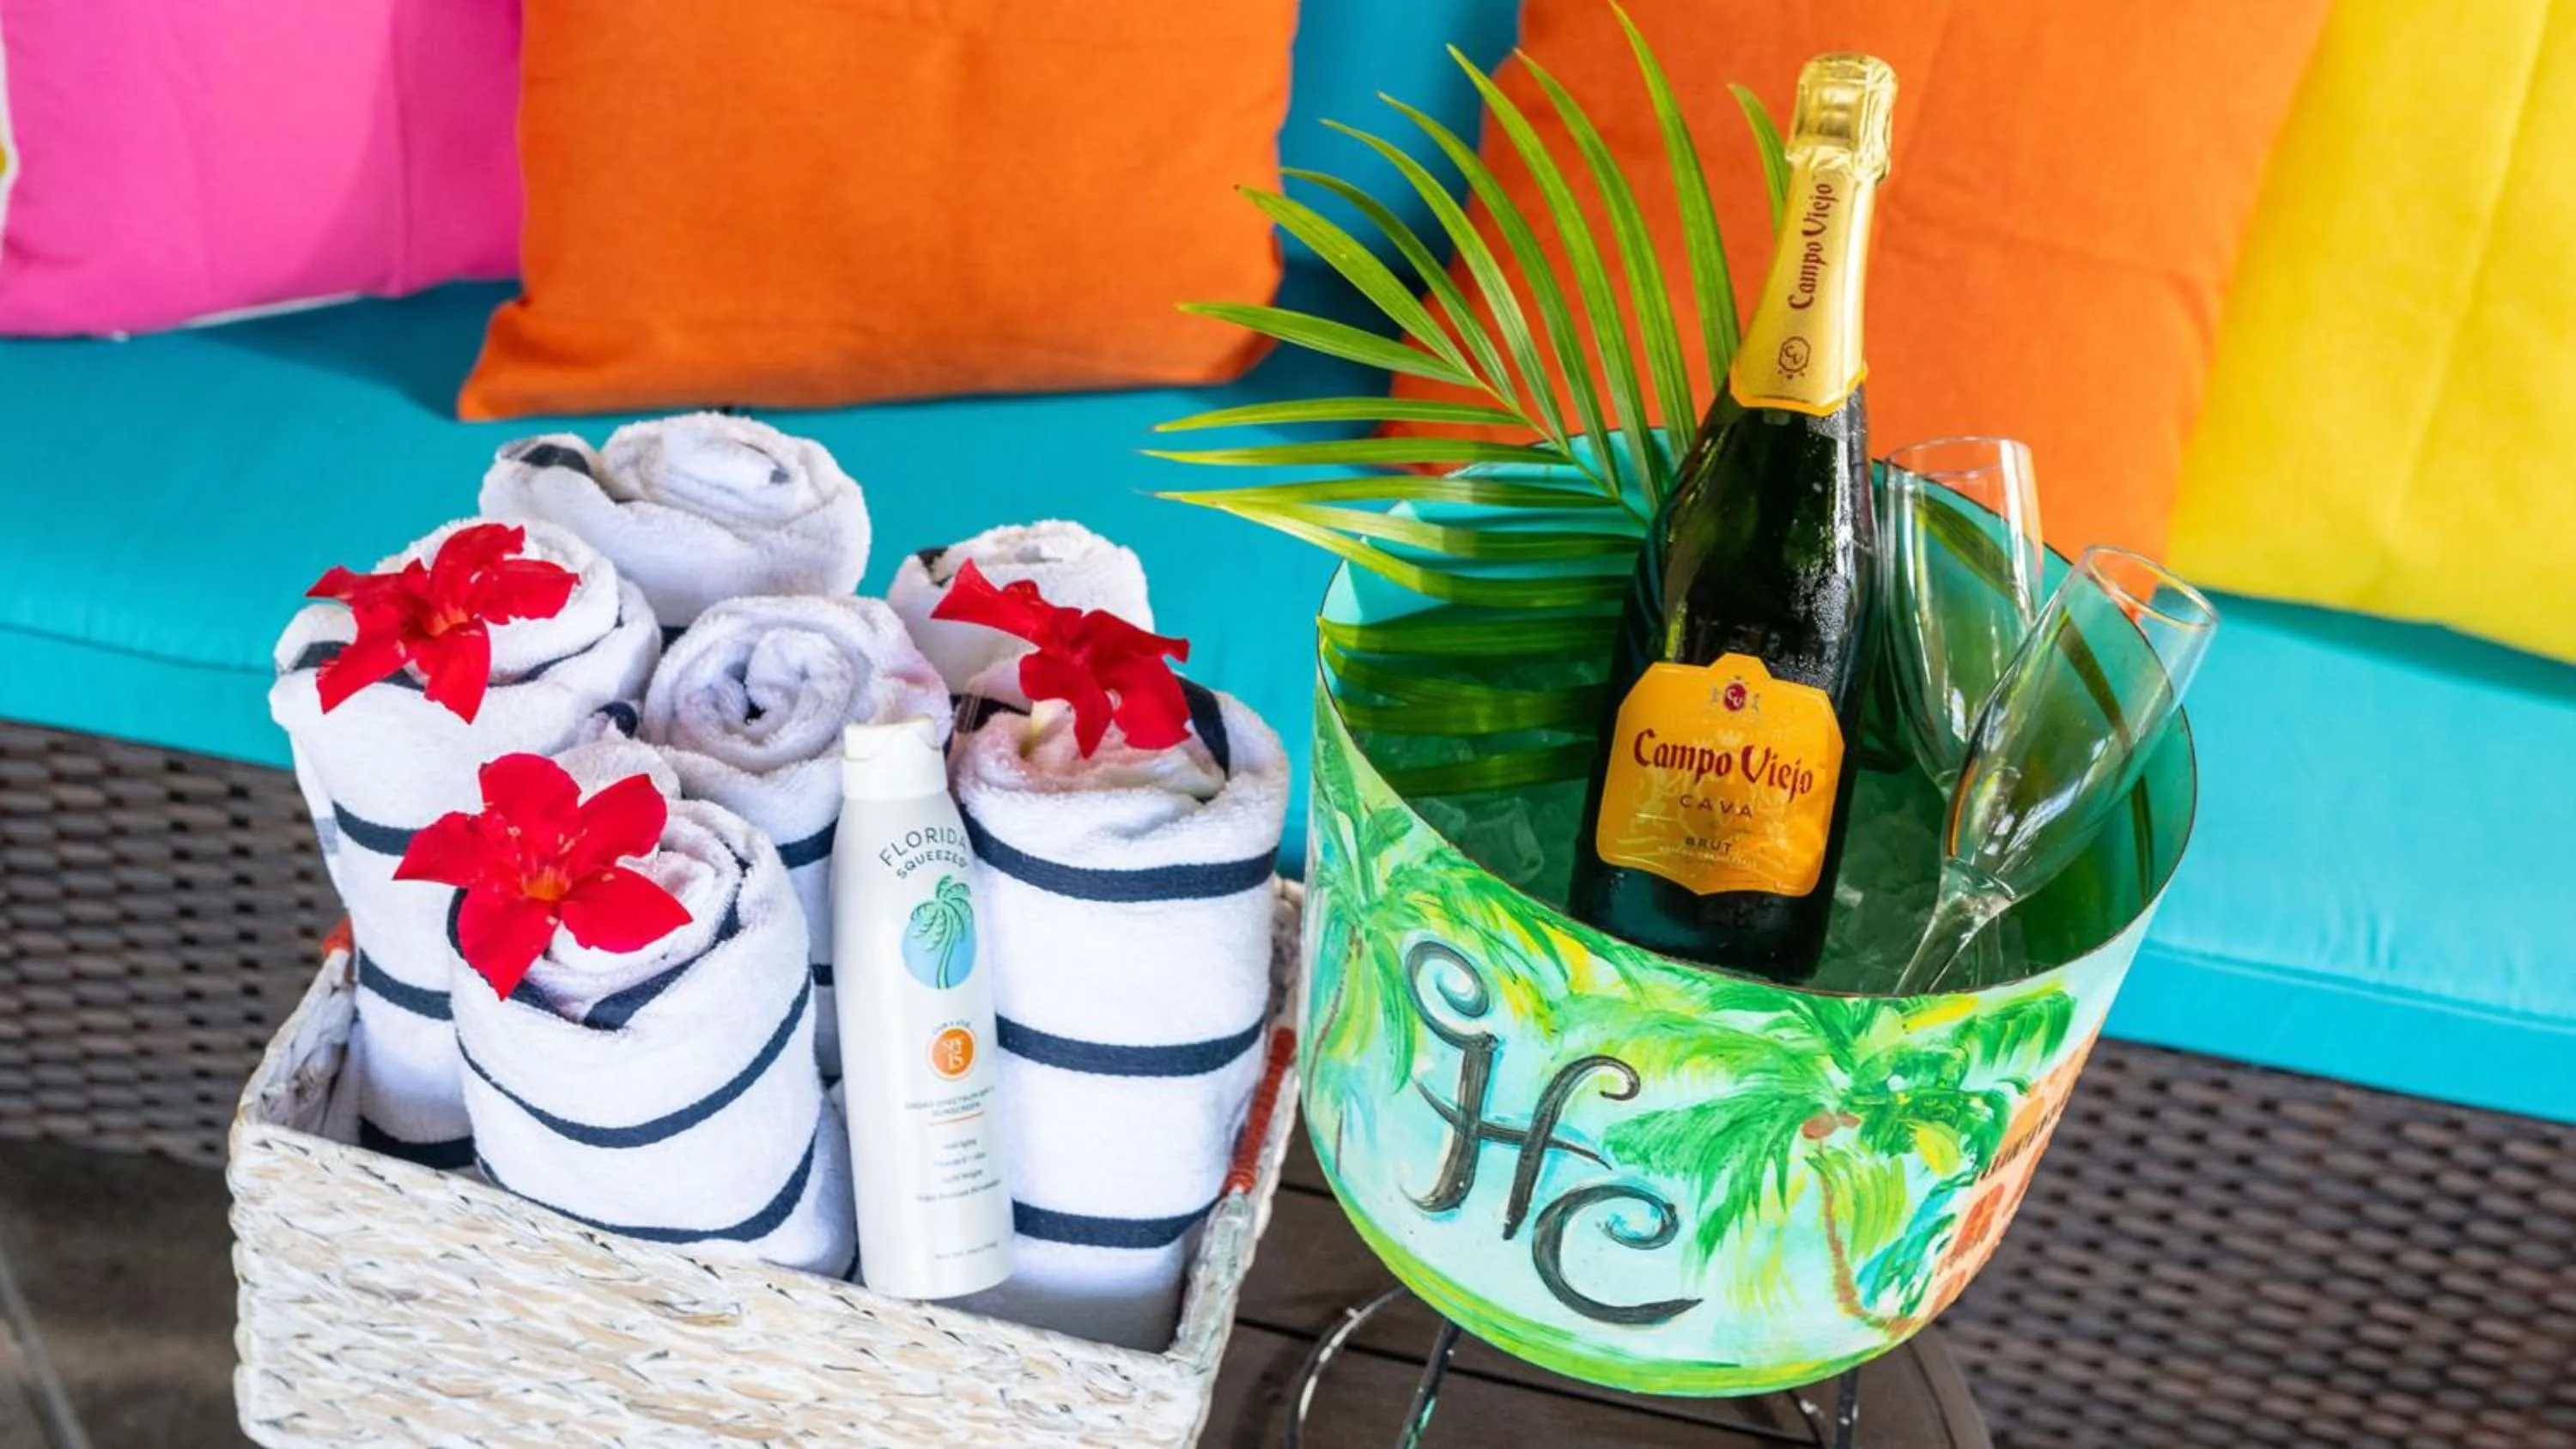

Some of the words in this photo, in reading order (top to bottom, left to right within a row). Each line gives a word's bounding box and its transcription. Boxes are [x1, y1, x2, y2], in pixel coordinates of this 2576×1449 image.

[1801, 181, 1839, 238] Viejo
[1788, 241, 1827, 311] Campo
[1633, 728, 1733, 784] Campo
[1741, 744, 1814, 803] Viejo
[1679, 793, 1753, 819] CAVA
[878, 827, 967, 867] FLORIDA
[895, 849, 968, 879] SQUEEZED
[1685, 835, 1733, 853] BRUT
